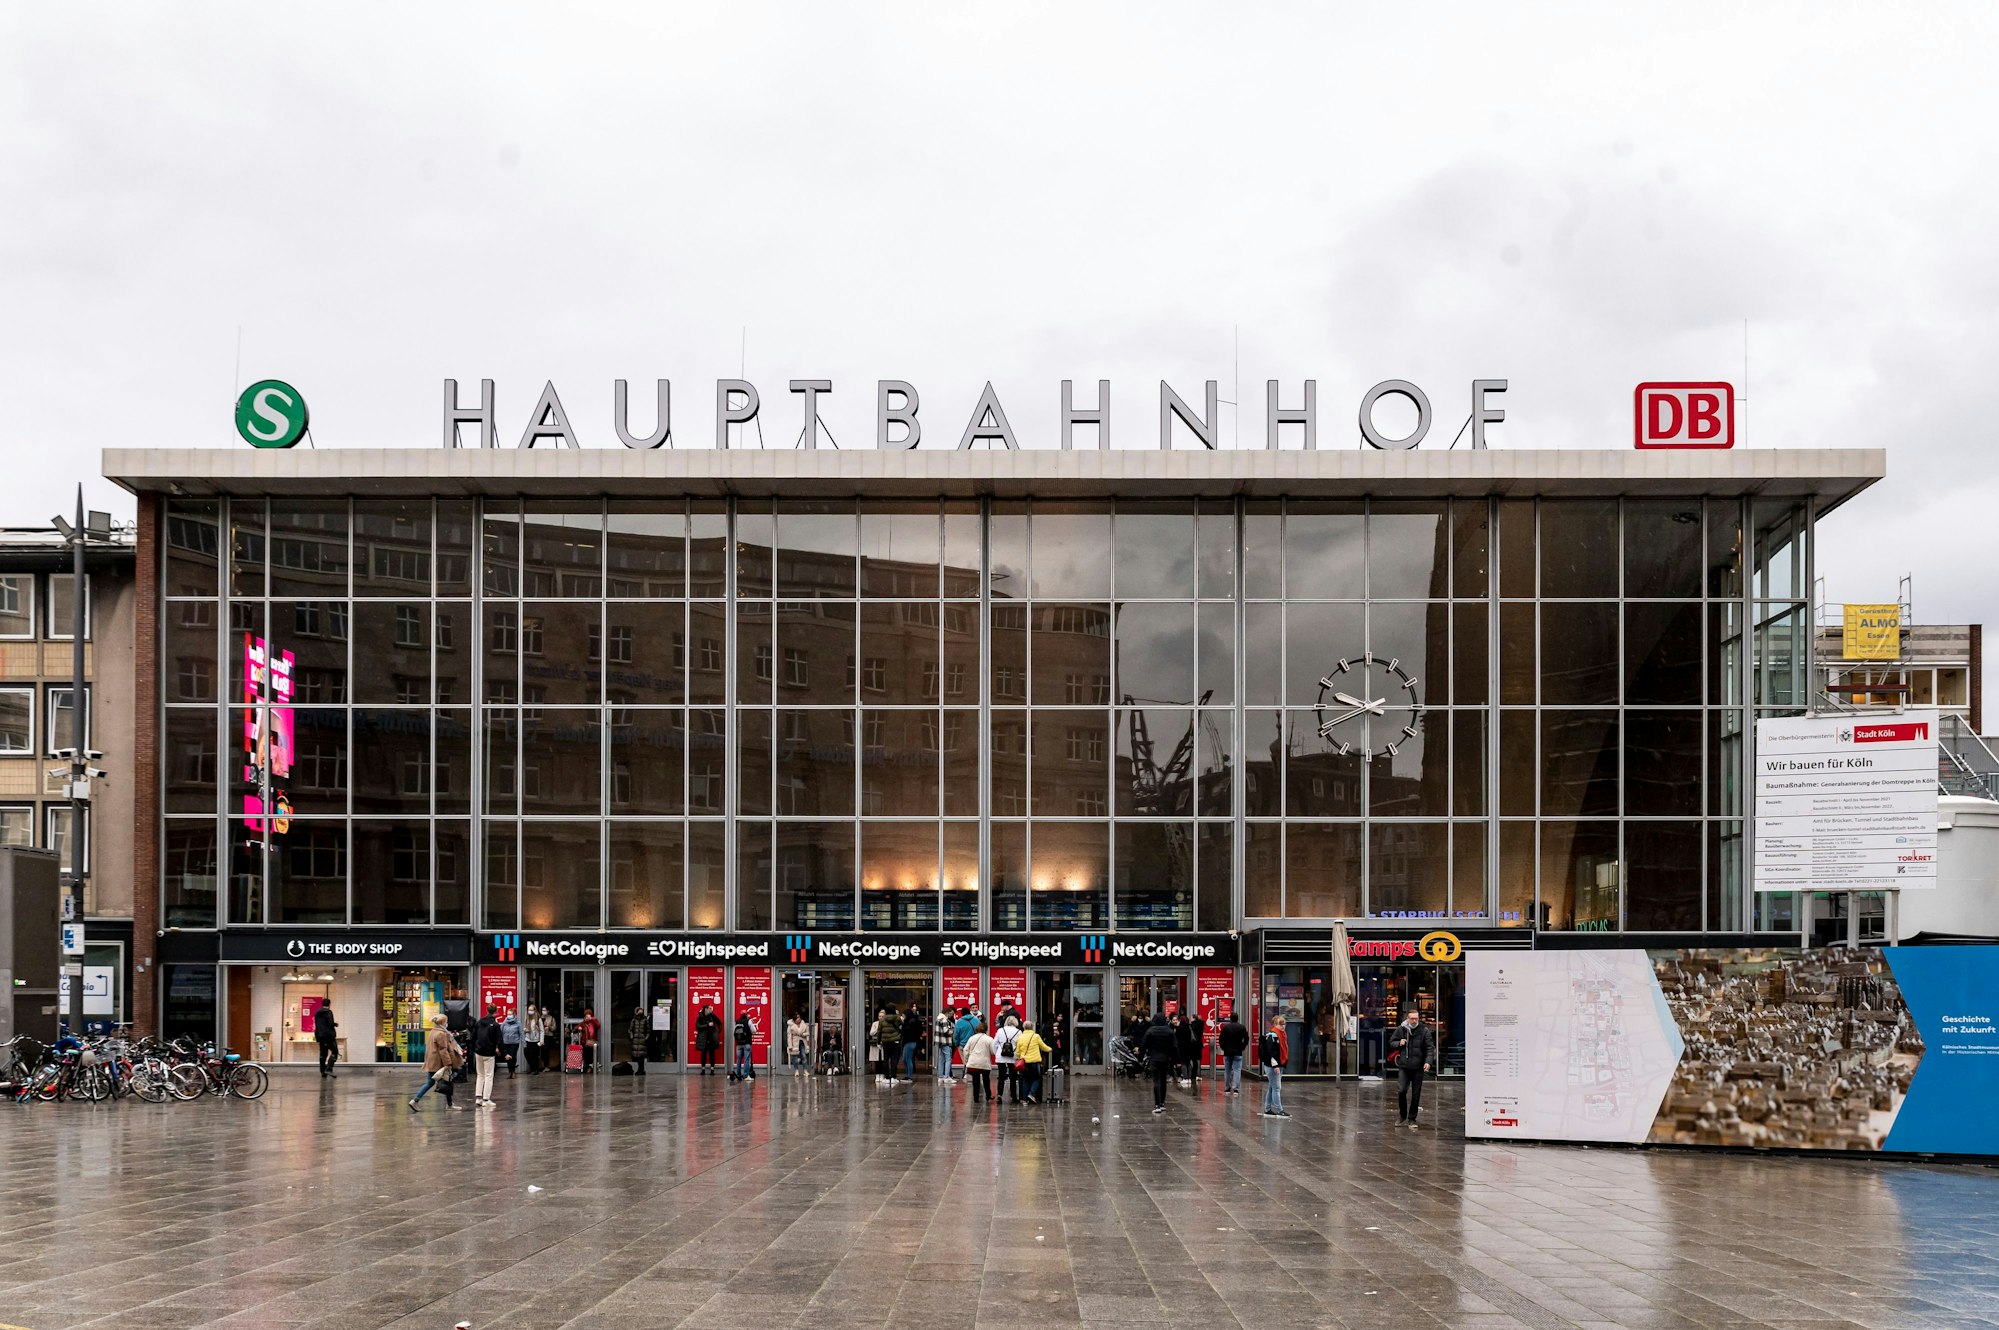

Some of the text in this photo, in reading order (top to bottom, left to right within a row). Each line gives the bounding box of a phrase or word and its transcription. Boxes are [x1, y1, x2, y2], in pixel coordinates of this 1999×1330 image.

[247, 388, 294, 442] S
[444, 379, 1508, 450] HAUPTBAHNHOF
[1648, 393, 1722, 440] DB
[1860, 618, 1898, 629] ALMO
[1856, 729, 1896, 738] Stadt Köln
[1766, 758, 1872, 770] Wir bauen für Köln
[1898, 850, 1932, 861] TORKRET
[308, 944, 402, 954] THE BODY SHOP
[526, 940, 629, 959] NetCologne
[678, 941, 768, 960] Highspeed
[818, 941, 921, 960] NetCologne
[971, 942, 1062, 960] Highspeed
[1112, 942, 1216, 960] NetCologne
[382, 986, 394, 1010] REFILL
[382, 1018, 394, 1042] REFILL
